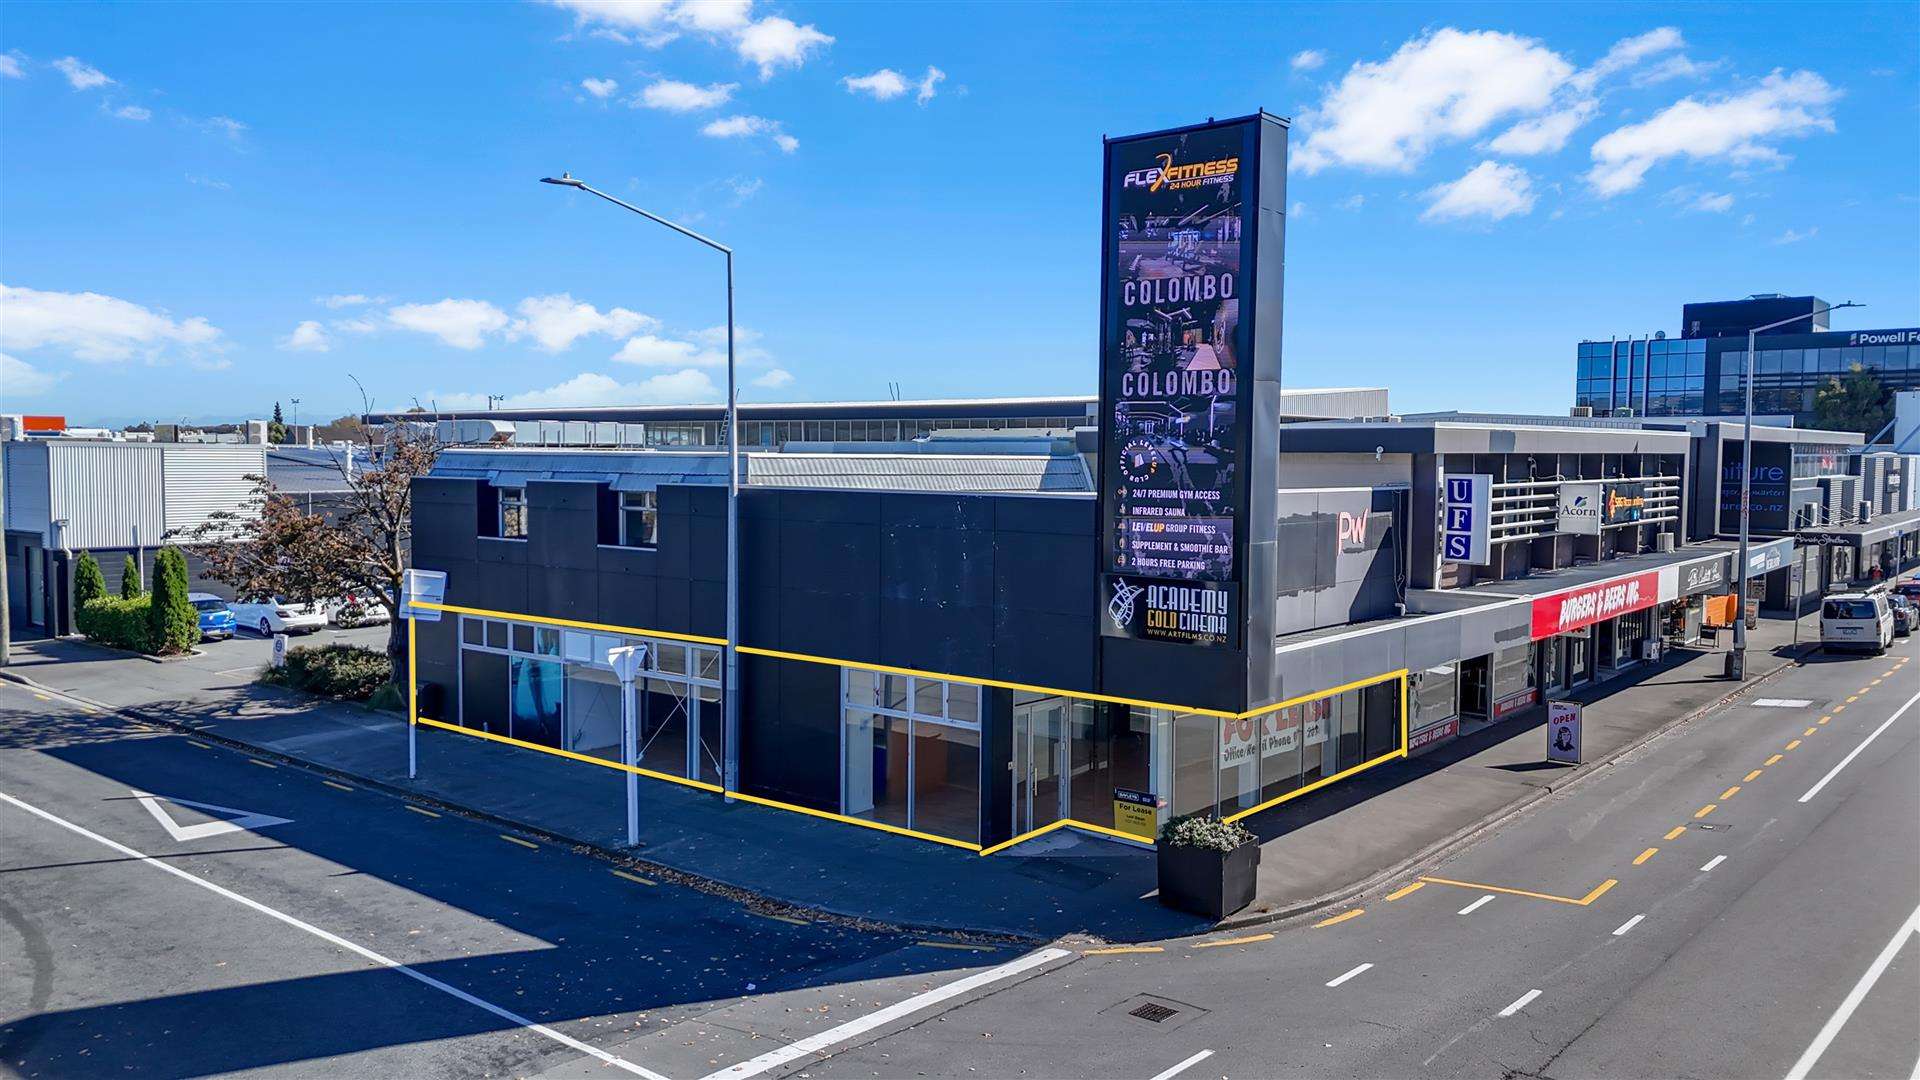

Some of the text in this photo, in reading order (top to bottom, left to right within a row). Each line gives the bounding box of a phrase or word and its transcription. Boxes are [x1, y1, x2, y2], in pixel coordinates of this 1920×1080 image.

[1169, 174, 1235, 190] 24 HOUR FITNESS
[1124, 273, 1233, 306] COLOMBO
[1859, 333, 1905, 344] Powell
[1122, 368, 1231, 397] COLOMBO
[1132, 489, 1221, 500] 24/7 PREMIUM GYM ACCESS
[1132, 506, 1186, 517] INFRARED SAUNA
[1561, 505, 1596, 516] Acorn
[1132, 522, 1216, 534] LEVELUP GROUP FITNESS
[1131, 540, 1229, 554] SUPPLEMENT & SMOOTHIE BAR
[1131, 557, 1206, 570] 2 HOURS FREE PARKING
[1146, 584, 1229, 616] ACADEMY
[1559, 591, 1597, 630] BURGERS
[1603, 583, 1627, 615] BEERS
[1147, 609, 1228, 635] GOLD CINEMA
[1553, 712, 1577, 726] OPEN
[1119, 803, 1152, 815] For Lease
